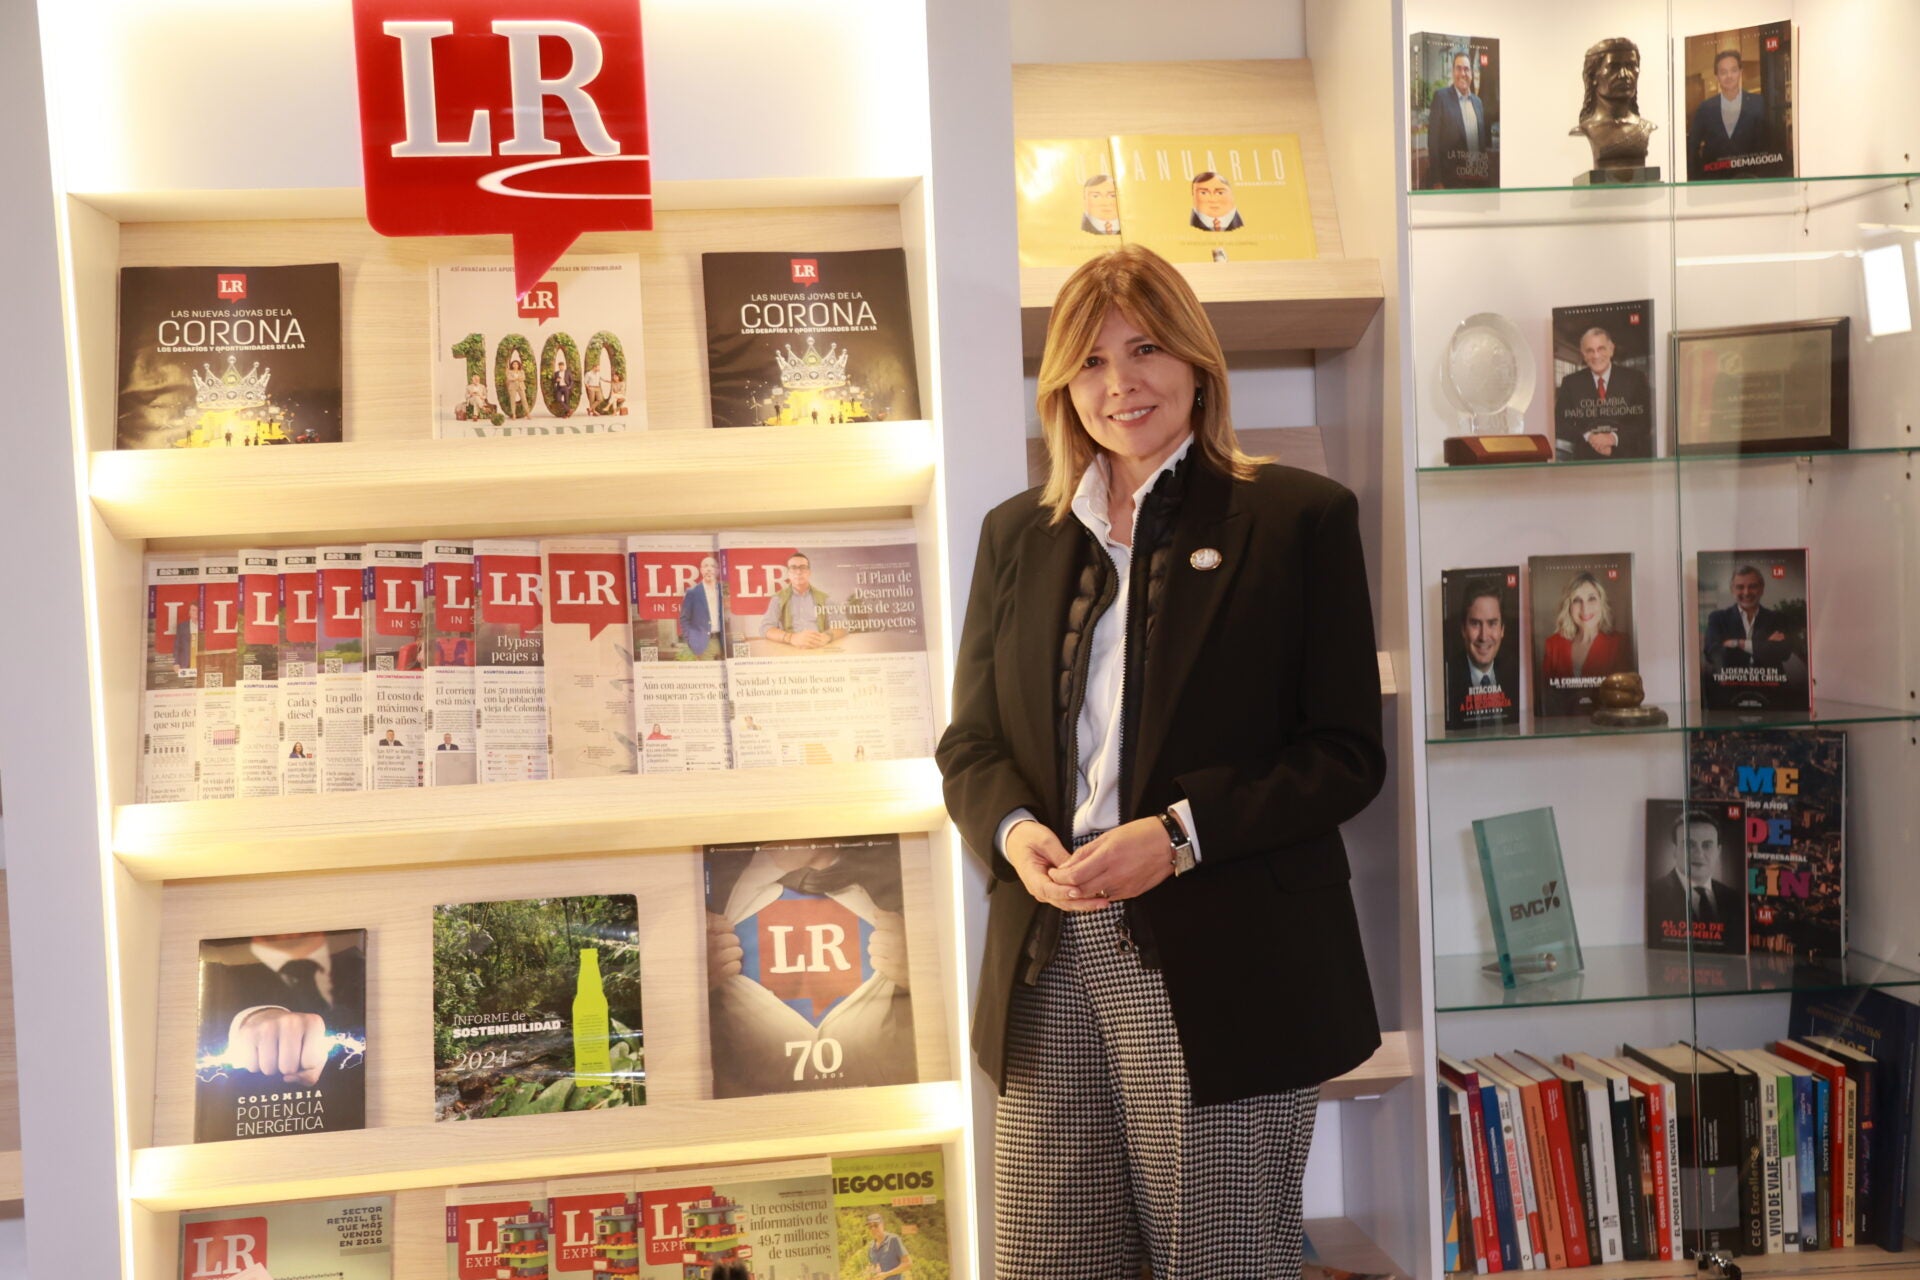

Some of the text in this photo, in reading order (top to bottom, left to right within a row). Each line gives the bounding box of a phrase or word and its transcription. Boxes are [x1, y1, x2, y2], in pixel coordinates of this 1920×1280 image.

[382, 19, 621, 158] LR
[793, 264, 816, 278] LR
[220, 279, 243, 293] LR
[521, 290, 555, 310] LR
[751, 292, 863, 302] LAS NUEVAS JOYAS DE LA
[171, 308, 293, 318] LAS NUEVAS JOYAS DE LA
[741, 301, 877, 329] CORONA
[158, 318, 306, 347] CORONA
[451, 331, 626, 421] 1000
[1580, 397, 1627, 409] COLOMBIA
[1586, 406, 1598, 417] DE
[1600, 404, 1644, 416] REGIONES
[644, 564, 700, 597] LR
[856, 569, 912, 585] El Plan de
[555, 570, 620, 606] LR
[855, 584, 914, 600] Desarrollo
[653, 603, 665, 612] IN
[849, 601, 873, 615] más
[875, 600, 890, 614] de
[893, 601, 915, 614] 320
[391, 619, 403, 629] IN
[451, 615, 463, 625] IN
[830, 616, 917, 633] megaproyectos
[497, 634, 541, 651] Flypass
[491, 650, 529, 665] peajes
[1713, 674, 1748, 682] TIEMPOS
[1749, 674, 1760, 682] DE
[1720, 667, 1778, 675] LIDERAZGO EN
[661, 682, 674, 690] con
[1549, 677, 1561, 687] LA
[325, 693, 338, 703] Un
[377, 691, 424, 701] El costo de
[436, 687, 447, 696] El
[483, 687, 497, 695] Los
[643, 691, 717, 703] no superan de
[287, 698, 310, 708] Cada
[483, 695, 498, 703] con
[500, 695, 507, 703] la
[153, 708, 192, 719] Deuda de
[325, 704, 344, 714] más
[377, 703, 419, 713] máximos
[505, 704, 512, 712] de
[153, 721, 180, 731] que su
[377, 714, 417, 725] dos años
[1737, 765, 1799, 796] ME
[1747, 817, 1791, 846] DE
[768, 924, 851, 974] LR
[452, 1011, 526, 1026] INFORME de
[452, 1020, 561, 1039] SOSTENIBILIDAD
[455, 1049, 508, 1071] 2024
[785, 1037, 843, 1081] 70
[238, 1089, 323, 1104] COLOMBIA
[237, 1101, 324, 1120] POTENCIA
[236, 1114, 324, 1136] ENERGÉTICA
[1669, 1118, 1677, 1167] ENCUESTAS
[1672, 1185, 1679, 1197] DE
[1766, 1156, 1782, 1237] VIVO DE VIAJE,
[342, 1206, 383, 1216] SECTOR
[750, 1199, 828, 1216] Un ecosistema
[370, 1214, 383, 1222] EL
[750, 1214, 829, 1232] informativo de
[337, 1223, 359, 1232] QUE
[1674, 1228, 1681, 1237] EL
[1751, 1219, 1761, 1247] CEO
[339, 1239, 353, 1248] EN
[783, 1229, 830, 1244] millones
[192, 1233, 258, 1278] LR
[768, 1244, 831, 1260] de usuarios
